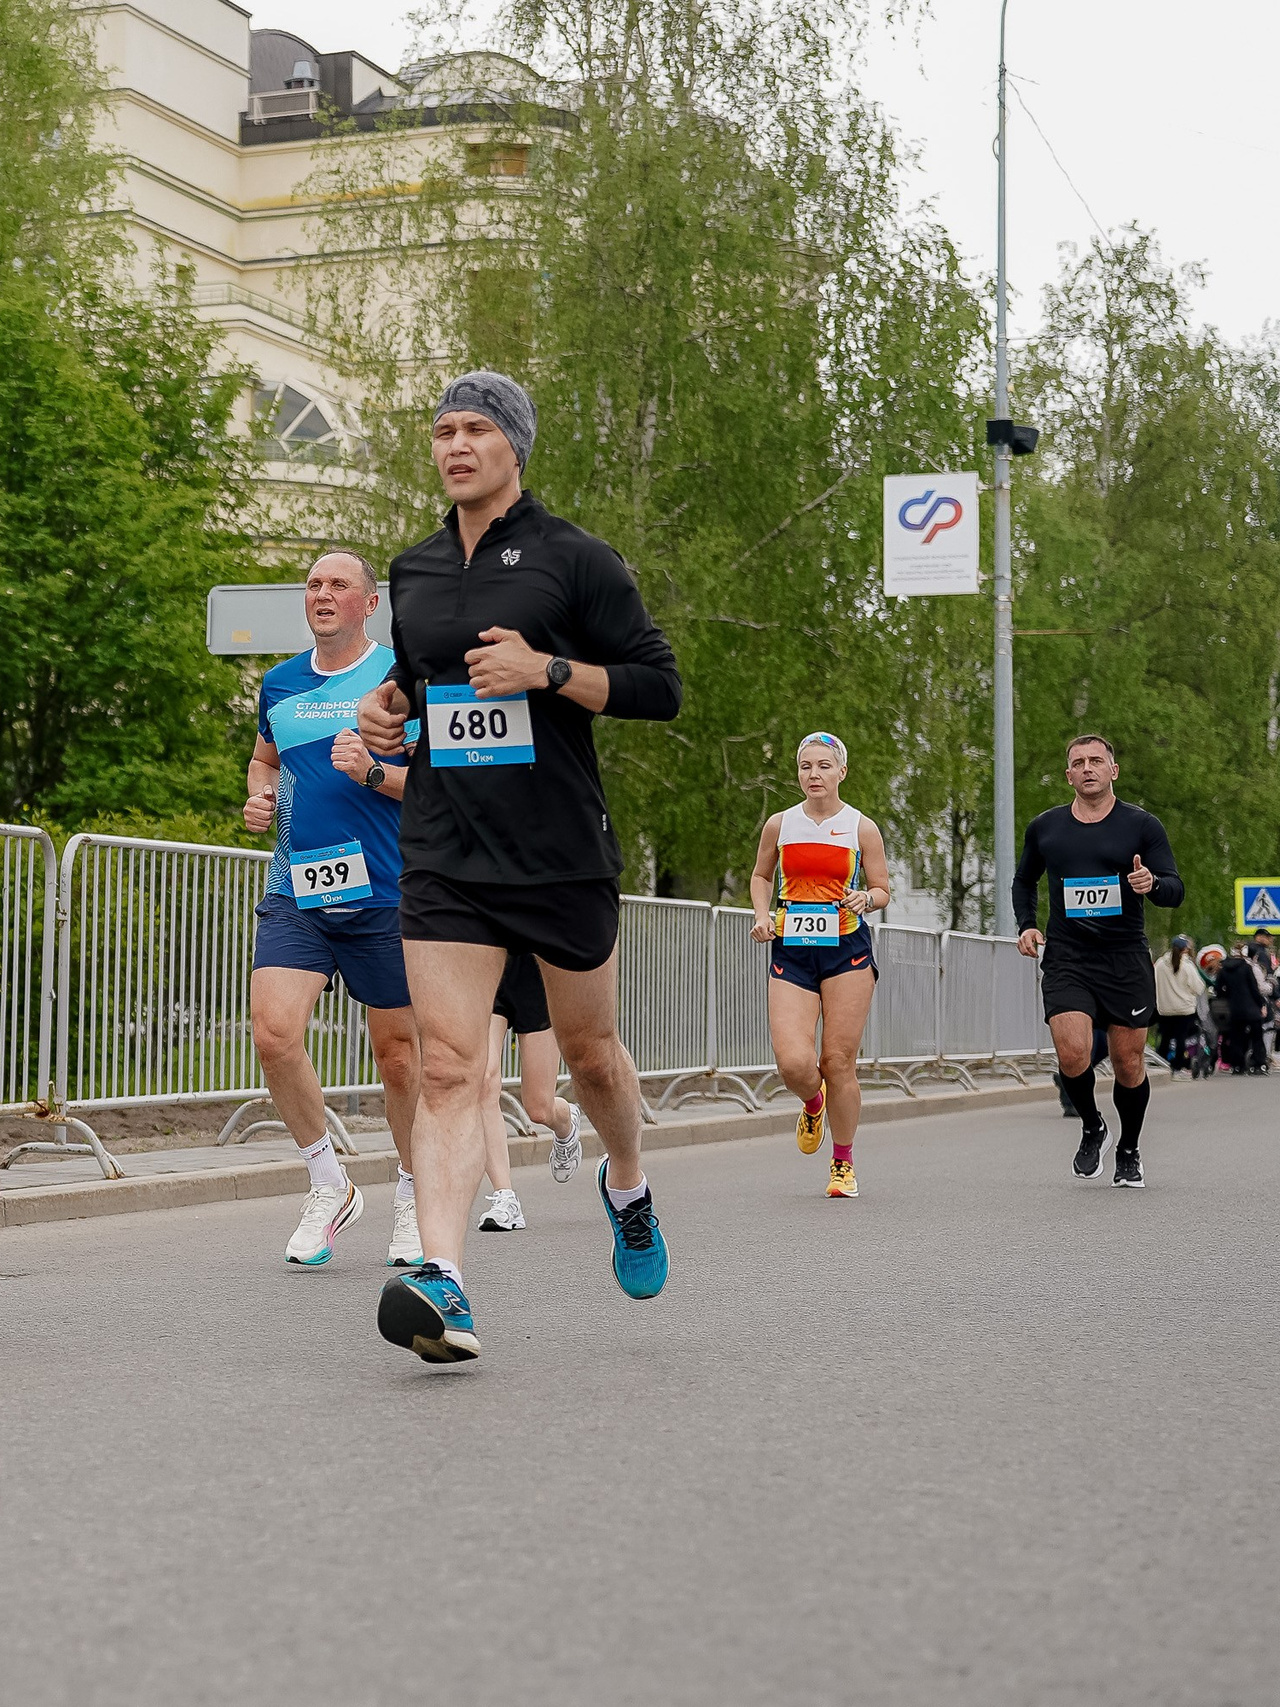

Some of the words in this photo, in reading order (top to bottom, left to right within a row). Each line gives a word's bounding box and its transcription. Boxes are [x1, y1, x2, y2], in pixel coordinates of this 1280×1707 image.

[296, 698, 360, 710] СТАЛЬНОЙ
[449, 709, 508, 741] 680
[304, 862, 349, 890] 939
[1075, 889, 1109, 905] 707
[793, 917, 827, 933] 730
